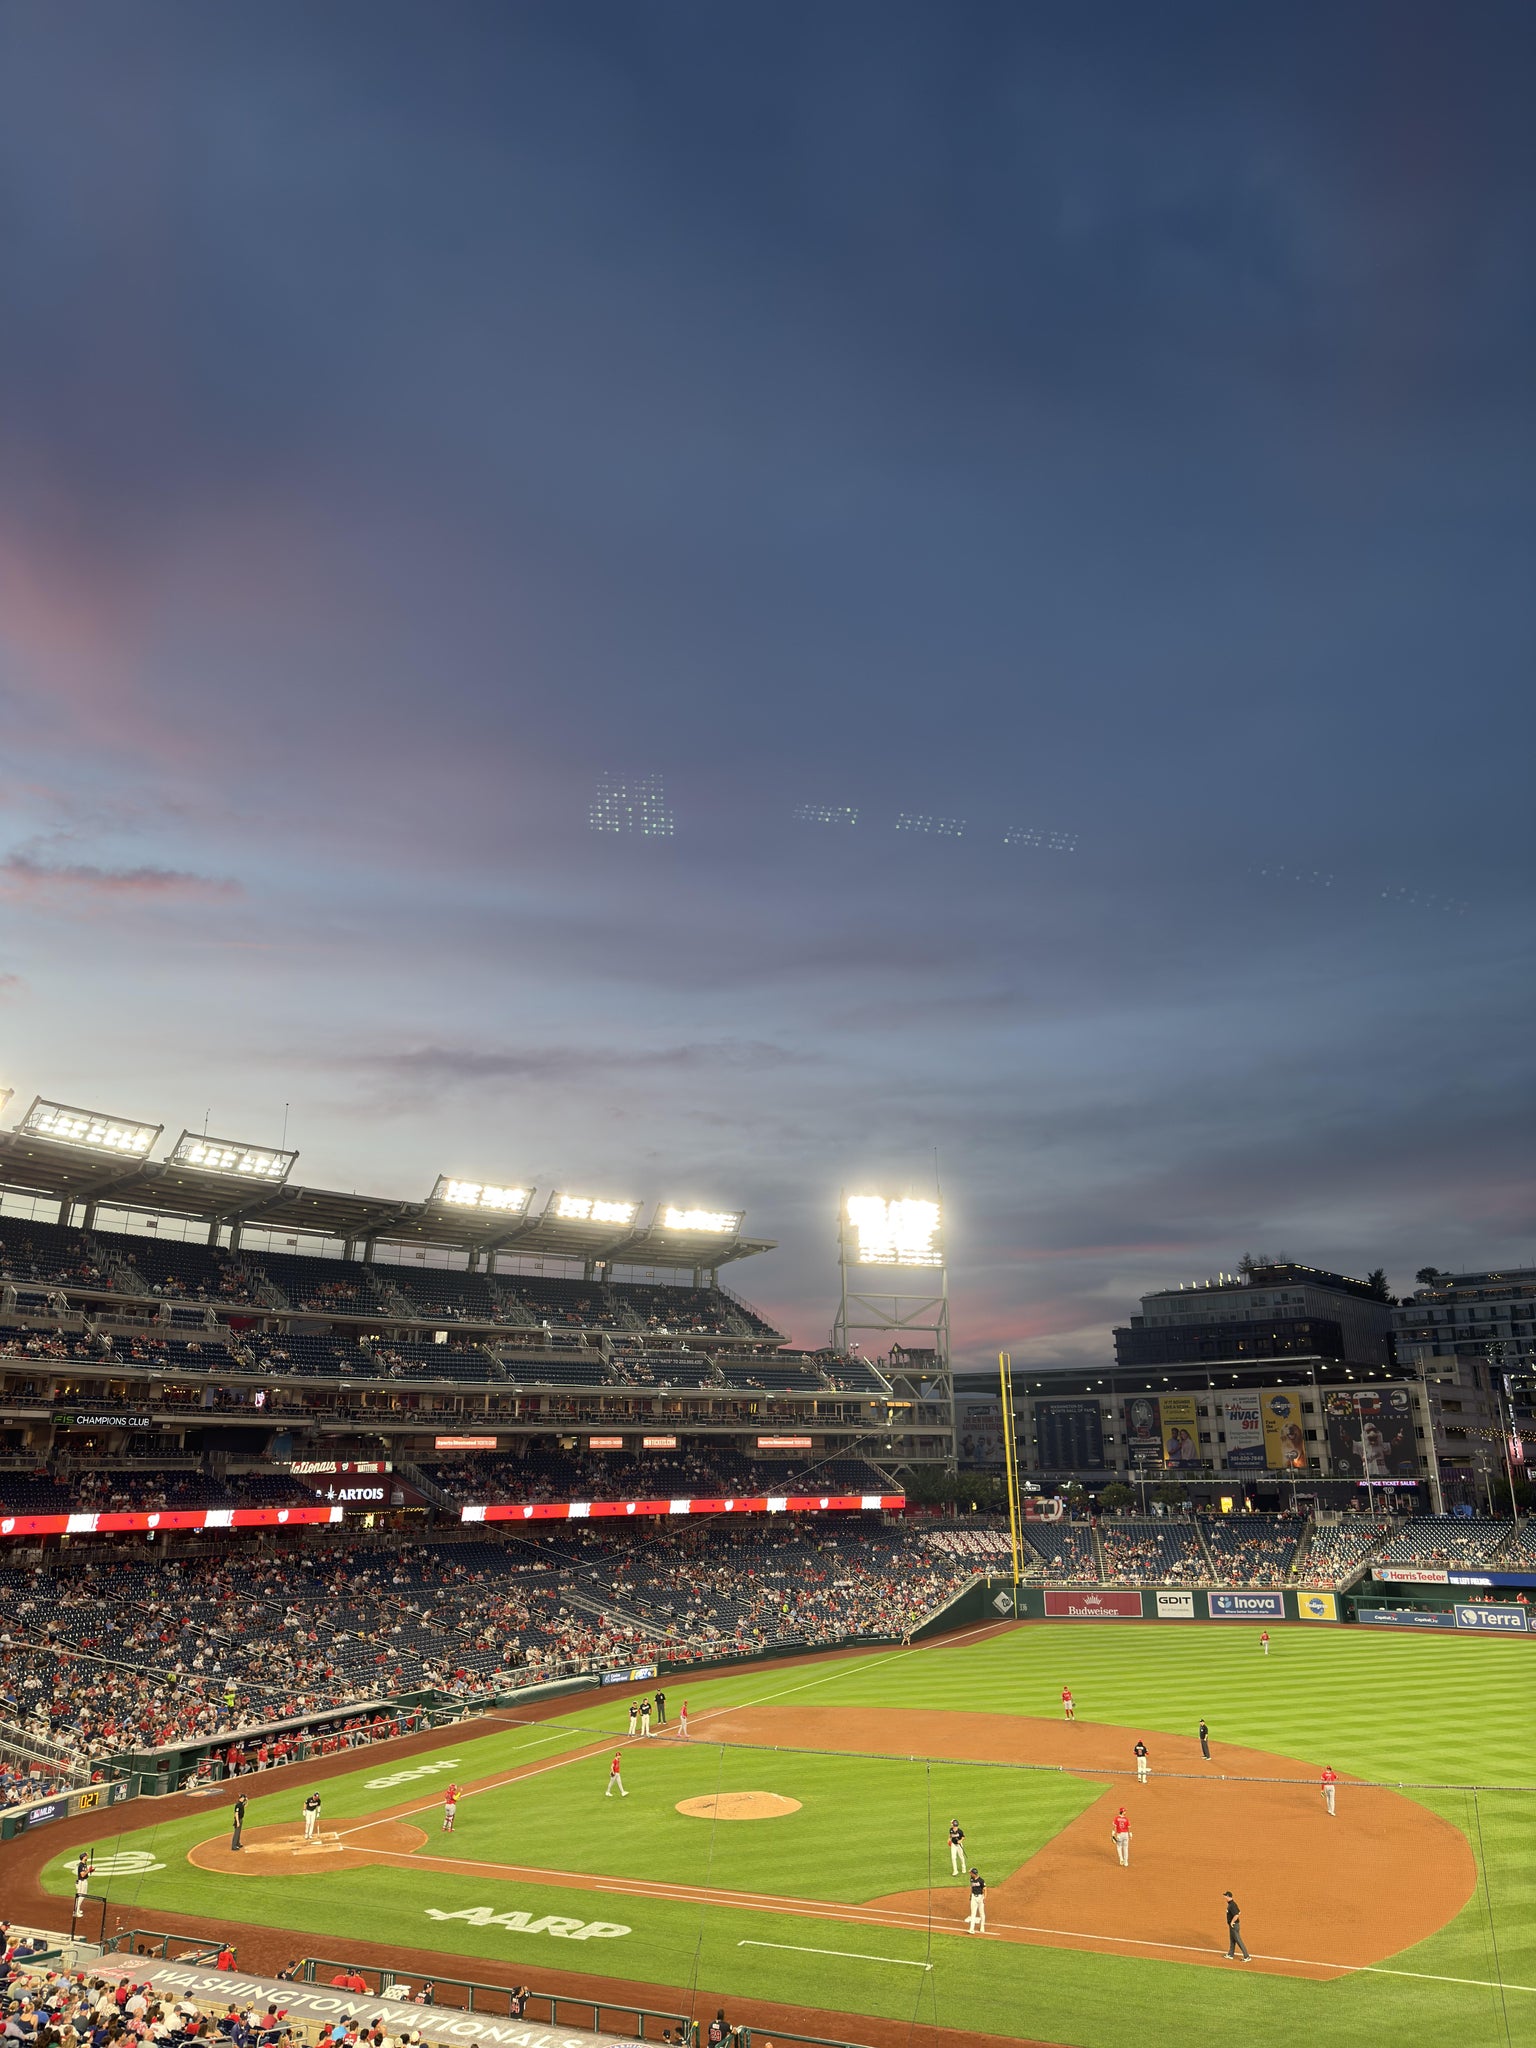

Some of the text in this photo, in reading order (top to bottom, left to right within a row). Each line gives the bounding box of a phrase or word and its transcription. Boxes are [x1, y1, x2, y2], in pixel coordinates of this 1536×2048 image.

[76, 1415, 127, 1426] CHAMPIONS
[128, 1417, 150, 1426] CLUB
[1230, 1411, 1259, 1420] HVAC
[1242, 1420, 1259, 1429] 911
[338, 1488, 384, 1500] ARTOIS
[1390, 1571, 1446, 1582] Harris Teeter
[1234, 1597, 1275, 1609] Inova
[1068, 1606, 1119, 1616] Budweiser
[1478, 1612, 1521, 1625] Terra
[114, 1792, 127, 1802] MLB
[424, 1906, 632, 1940] AARP
[149, 1969, 371, 2016] WASHINGTON
[366, 2008, 584, 2048] NATIONALS
